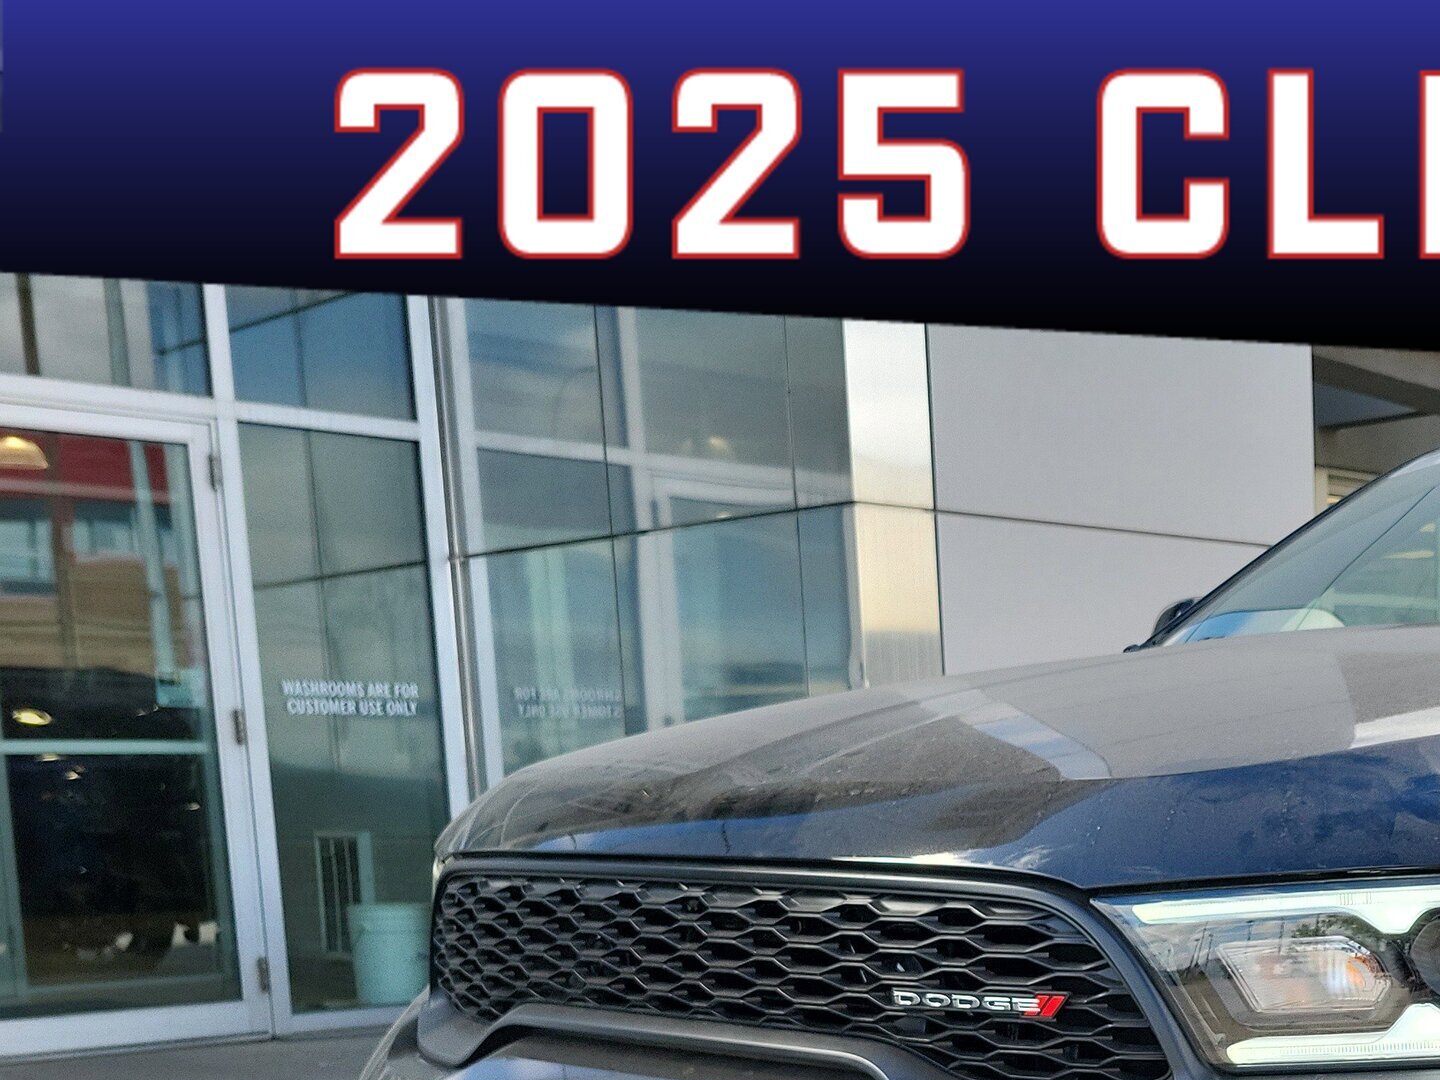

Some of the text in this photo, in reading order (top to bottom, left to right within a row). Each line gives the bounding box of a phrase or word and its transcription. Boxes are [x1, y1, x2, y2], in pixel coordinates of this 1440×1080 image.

[281, 679, 419, 698] WASHROOMS ARE FOR
[286, 698, 418, 716] CUSTOMER USE ONLY
[893, 990, 1041, 1012] DODGE
